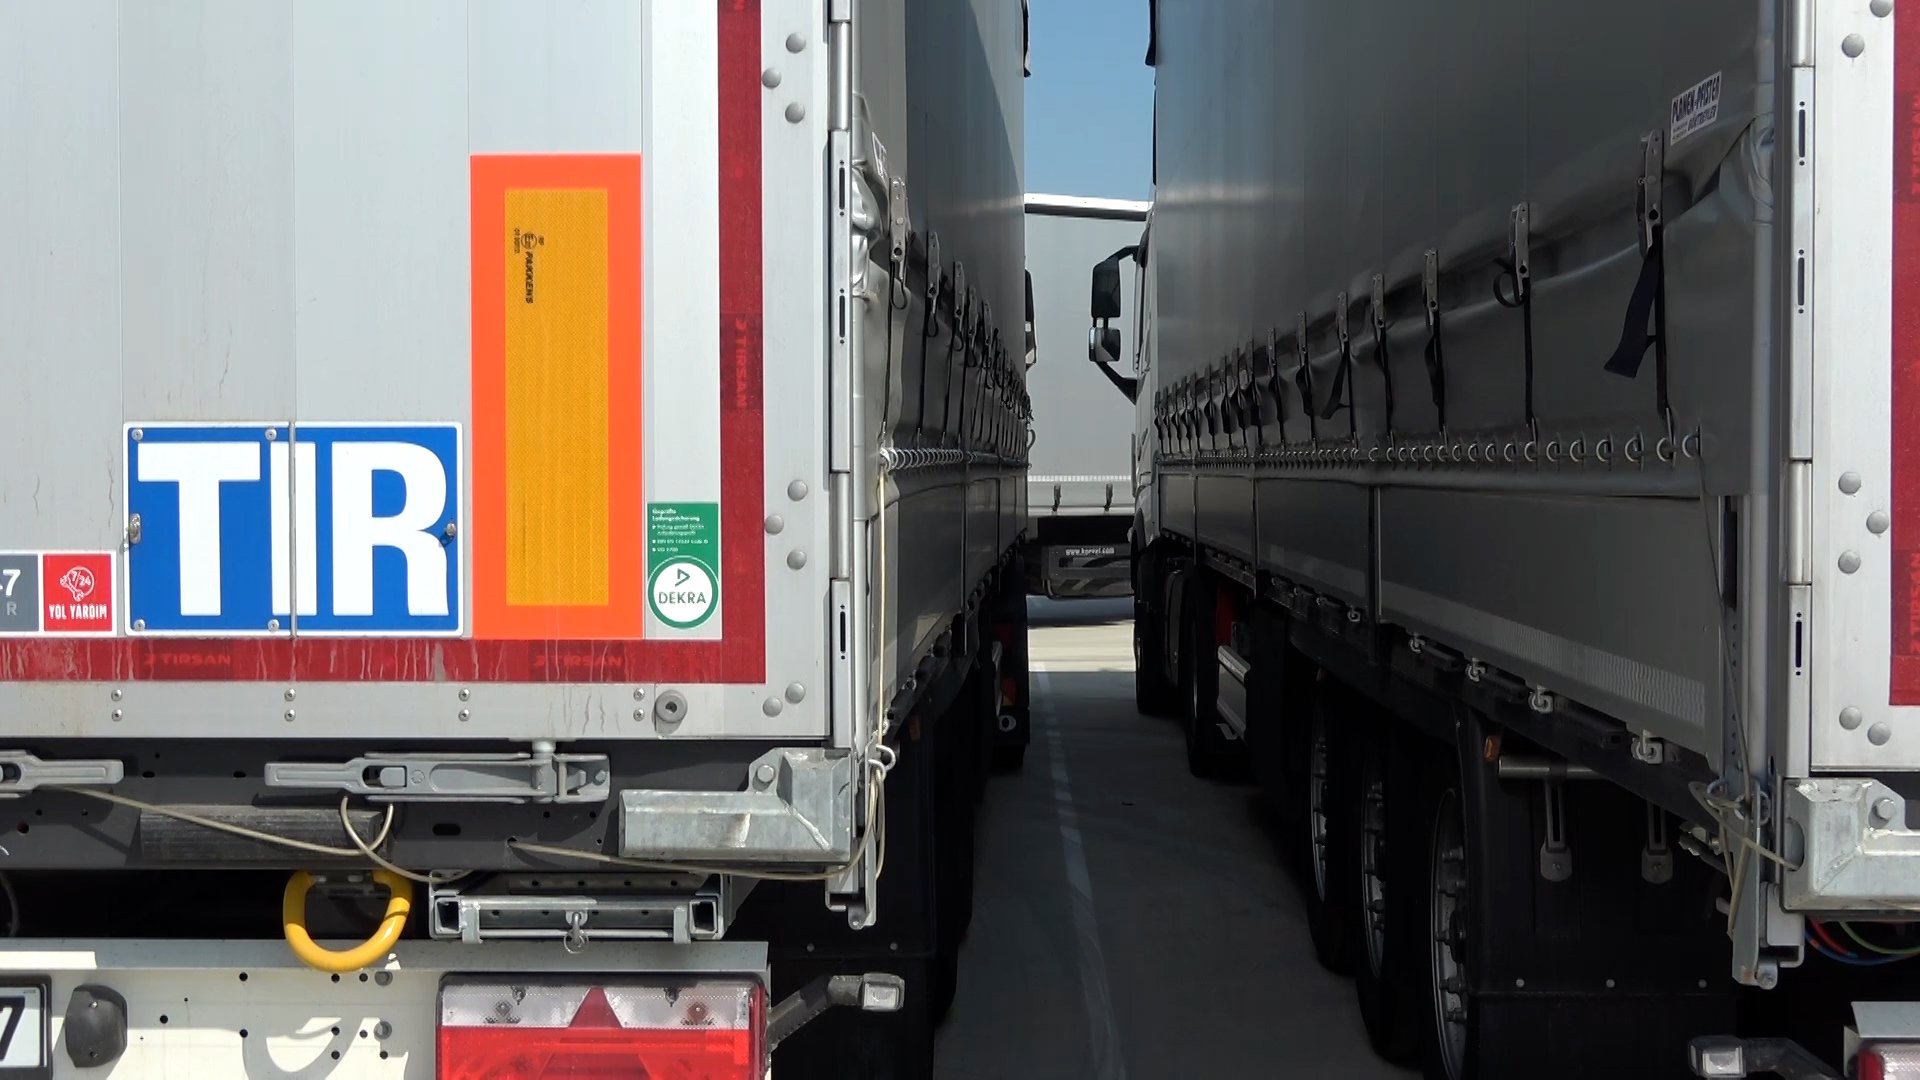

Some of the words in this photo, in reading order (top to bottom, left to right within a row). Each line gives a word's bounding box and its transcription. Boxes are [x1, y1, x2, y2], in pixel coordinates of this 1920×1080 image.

[138, 442, 449, 616] TIR
[0, 569, 21, 597] 7
[658, 591, 707, 604] DEKRA
[49, 603, 67, 619] YOL
[69, 603, 108, 619] YARDIM
[161, 653, 231, 665] TIRSAN
